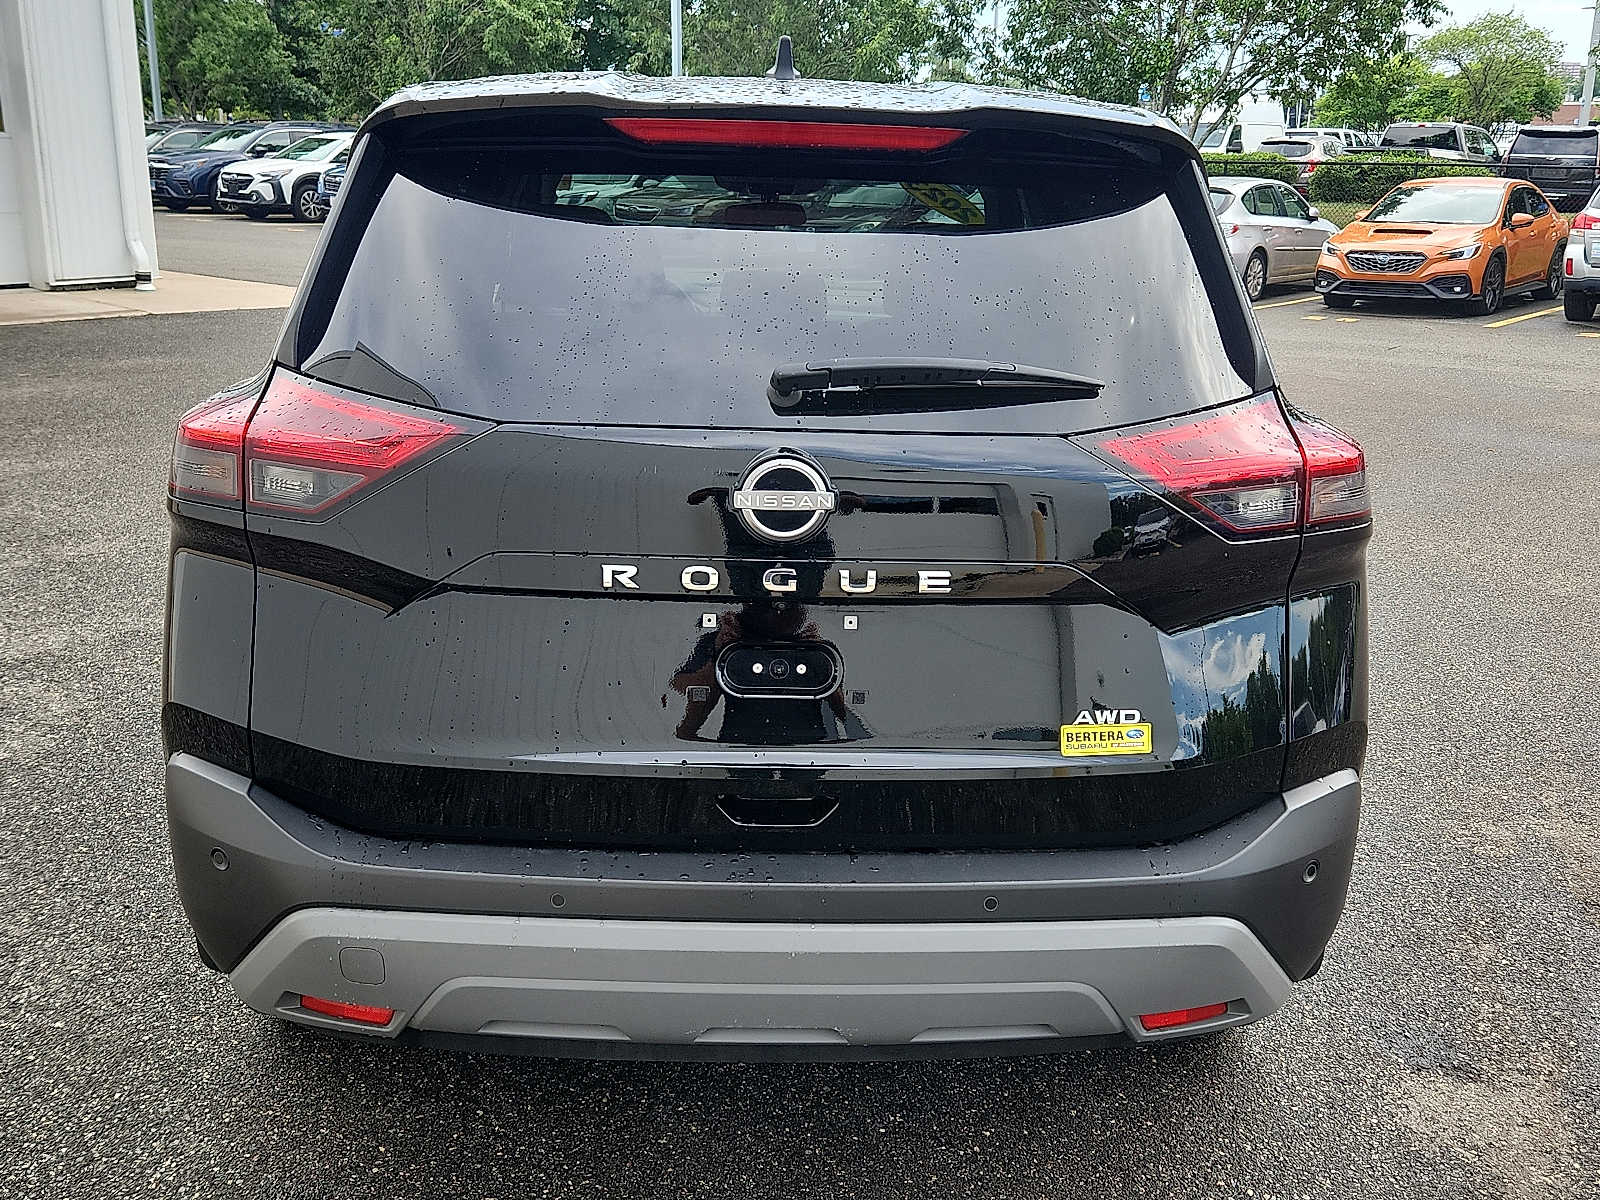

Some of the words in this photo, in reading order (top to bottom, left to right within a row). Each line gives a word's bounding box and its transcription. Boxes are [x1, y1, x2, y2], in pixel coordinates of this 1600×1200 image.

[735, 493, 834, 509] NISSAN
[601, 564, 952, 594] ROGUE
[1072, 709, 1141, 726] AWD
[1066, 730, 1124, 743] BERTERA
